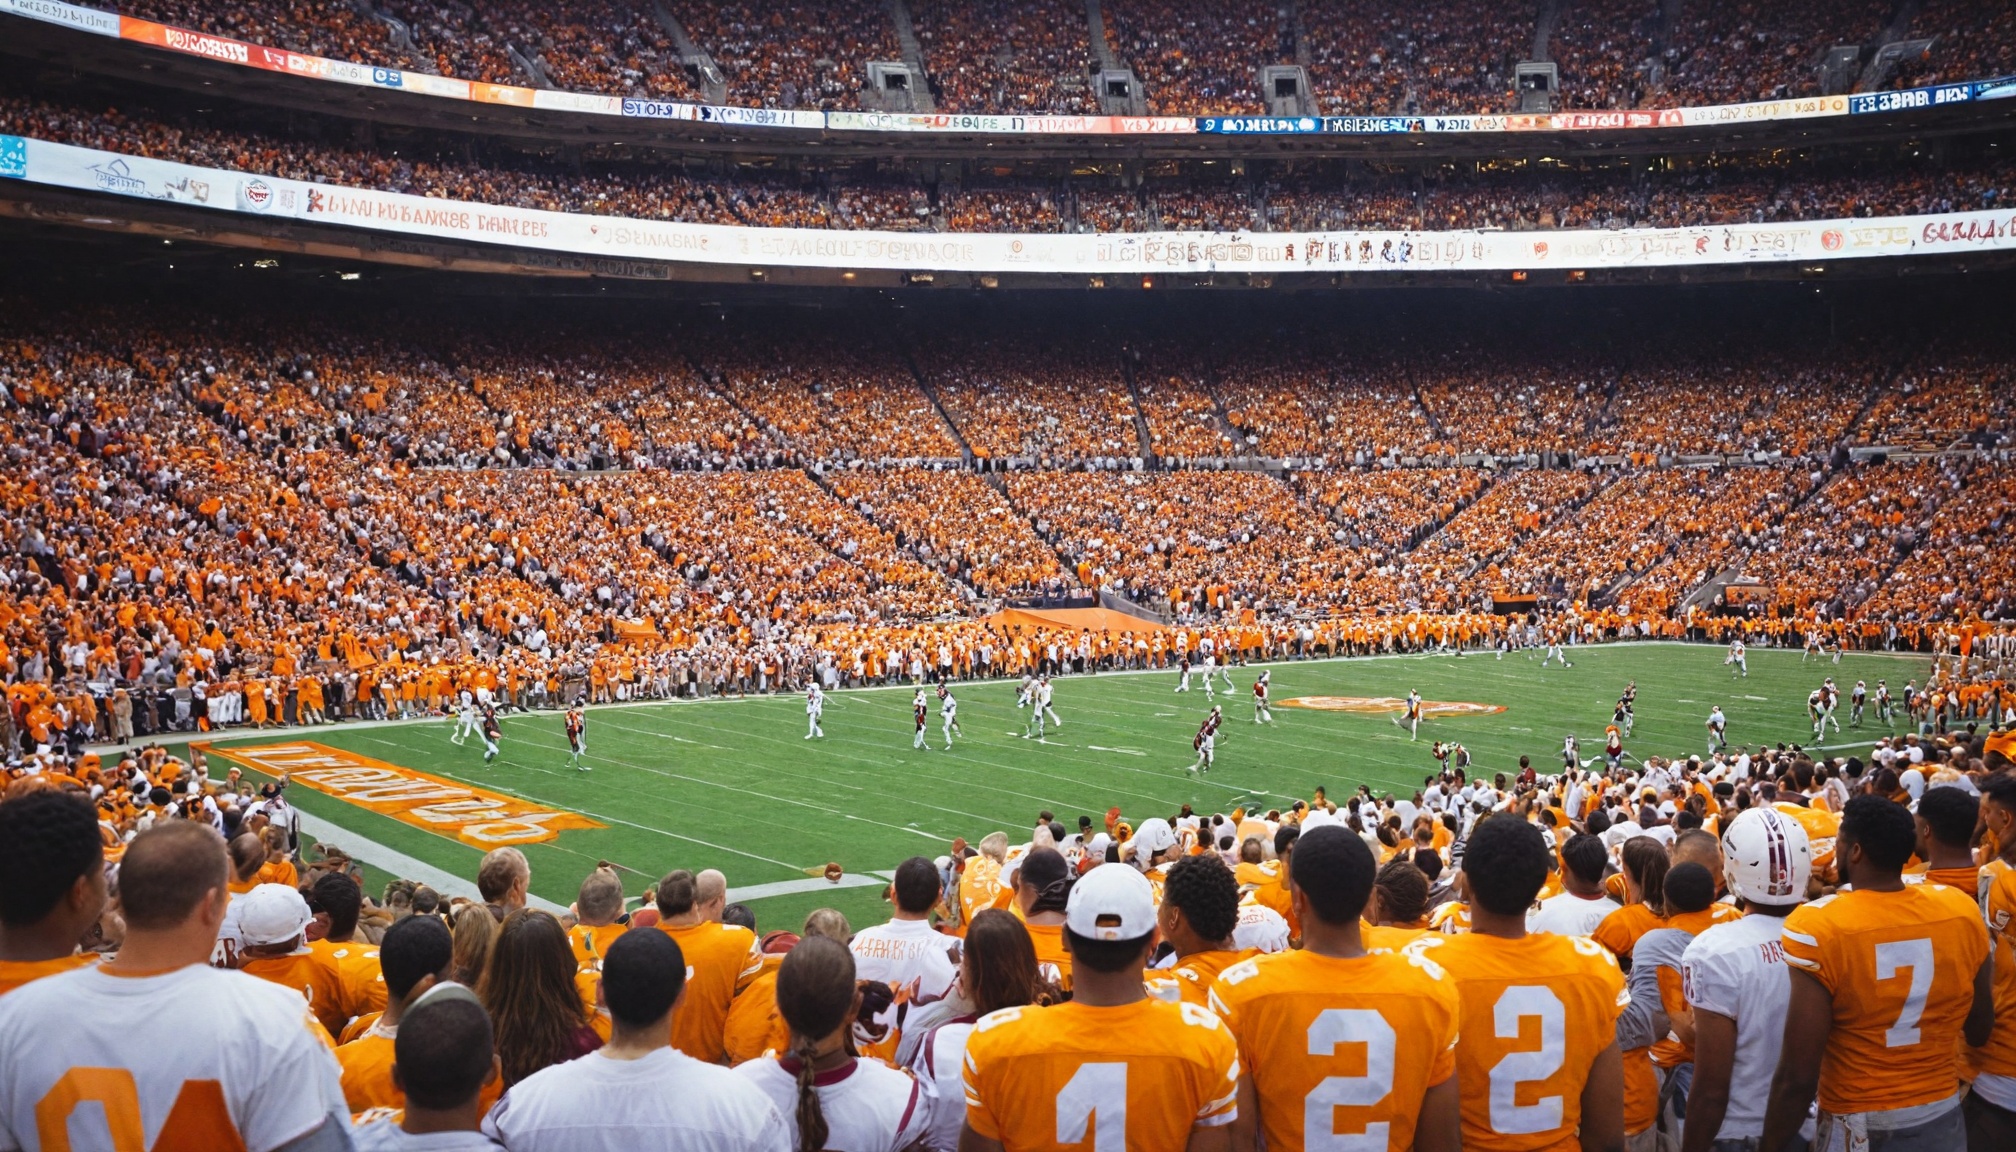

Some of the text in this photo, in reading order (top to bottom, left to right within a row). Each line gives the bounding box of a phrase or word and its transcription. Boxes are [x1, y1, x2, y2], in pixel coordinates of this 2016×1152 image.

[1489, 985, 1566, 1135] 2
[1875, 938, 1935, 1048] 7
[1304, 1008, 1397, 1152] 2
